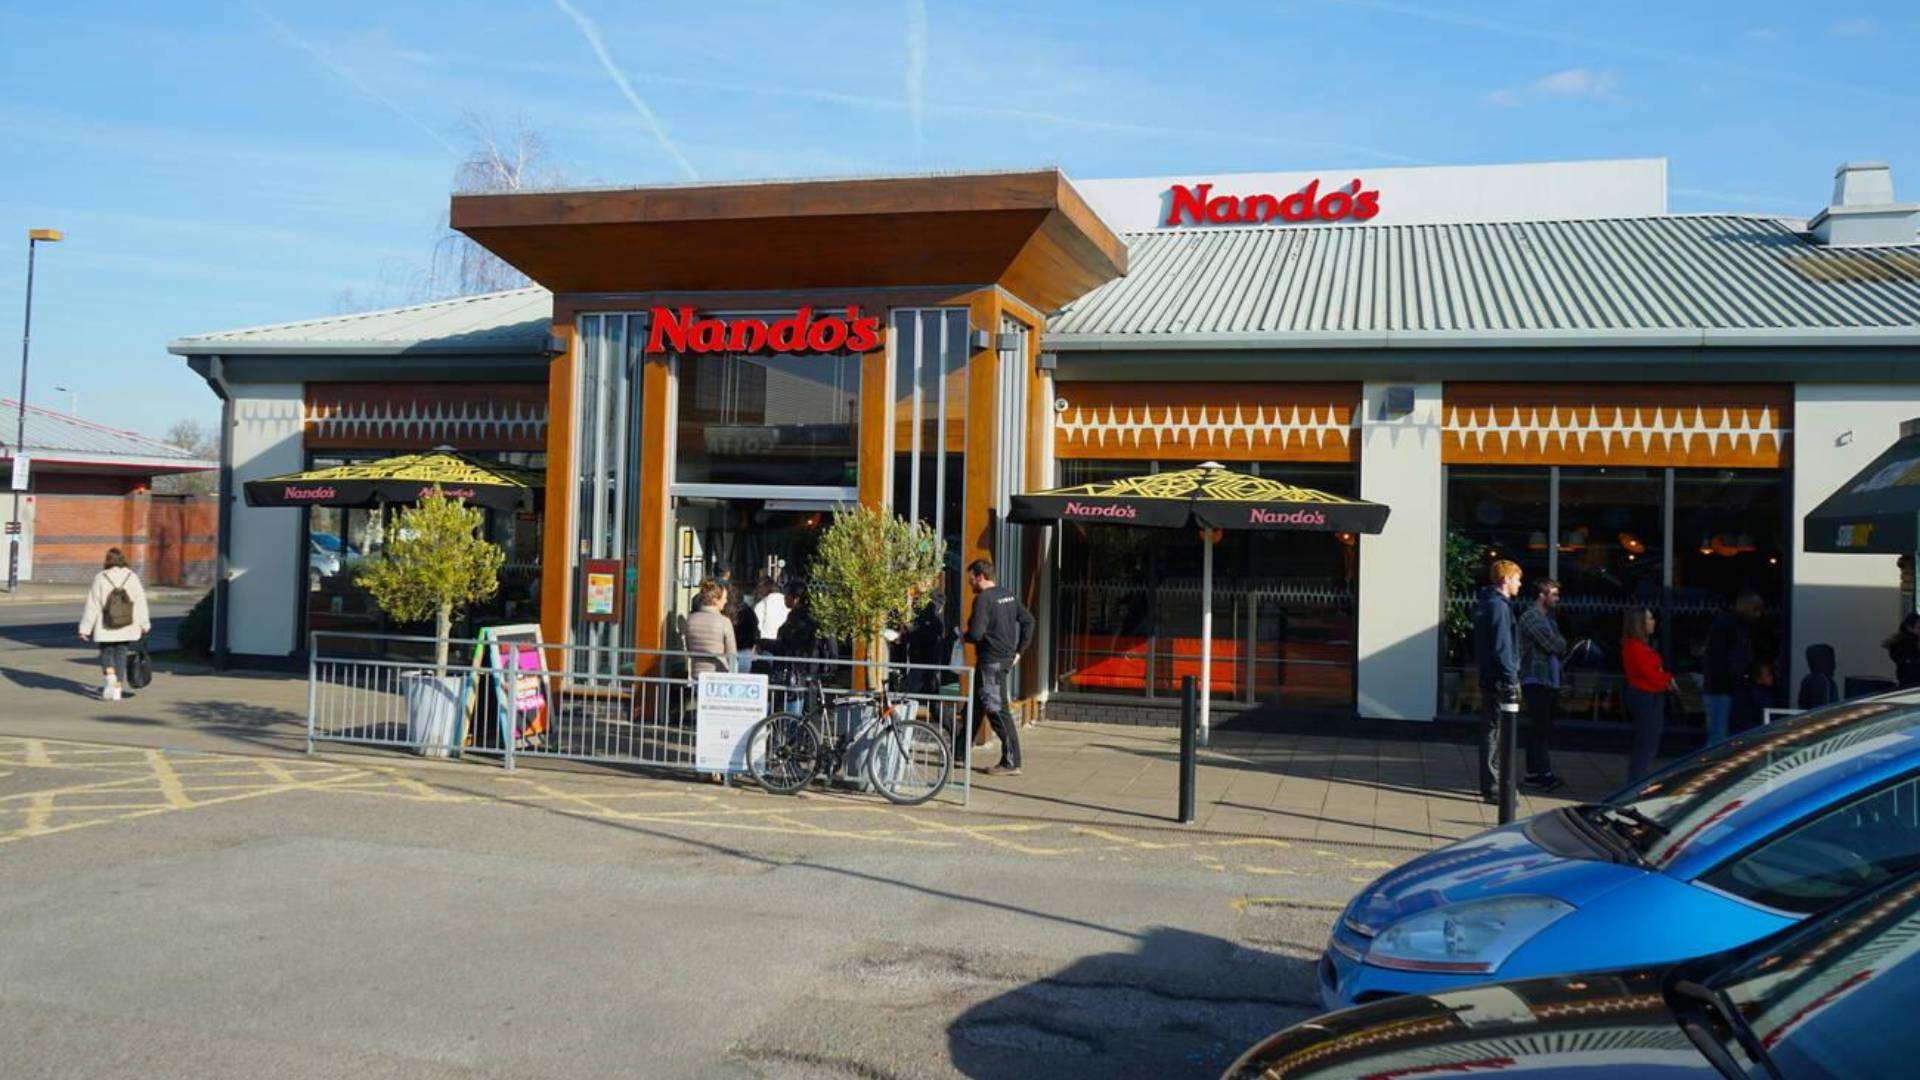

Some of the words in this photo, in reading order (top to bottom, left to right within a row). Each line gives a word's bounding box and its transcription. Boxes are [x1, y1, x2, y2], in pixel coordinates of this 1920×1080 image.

[1165, 178, 1380, 226] Nando's
[646, 304, 879, 353] Nando's
[284, 486, 336, 499] Nando's
[1065, 502, 1137, 518] Nando's
[1250, 509, 1325, 525] Nando's
